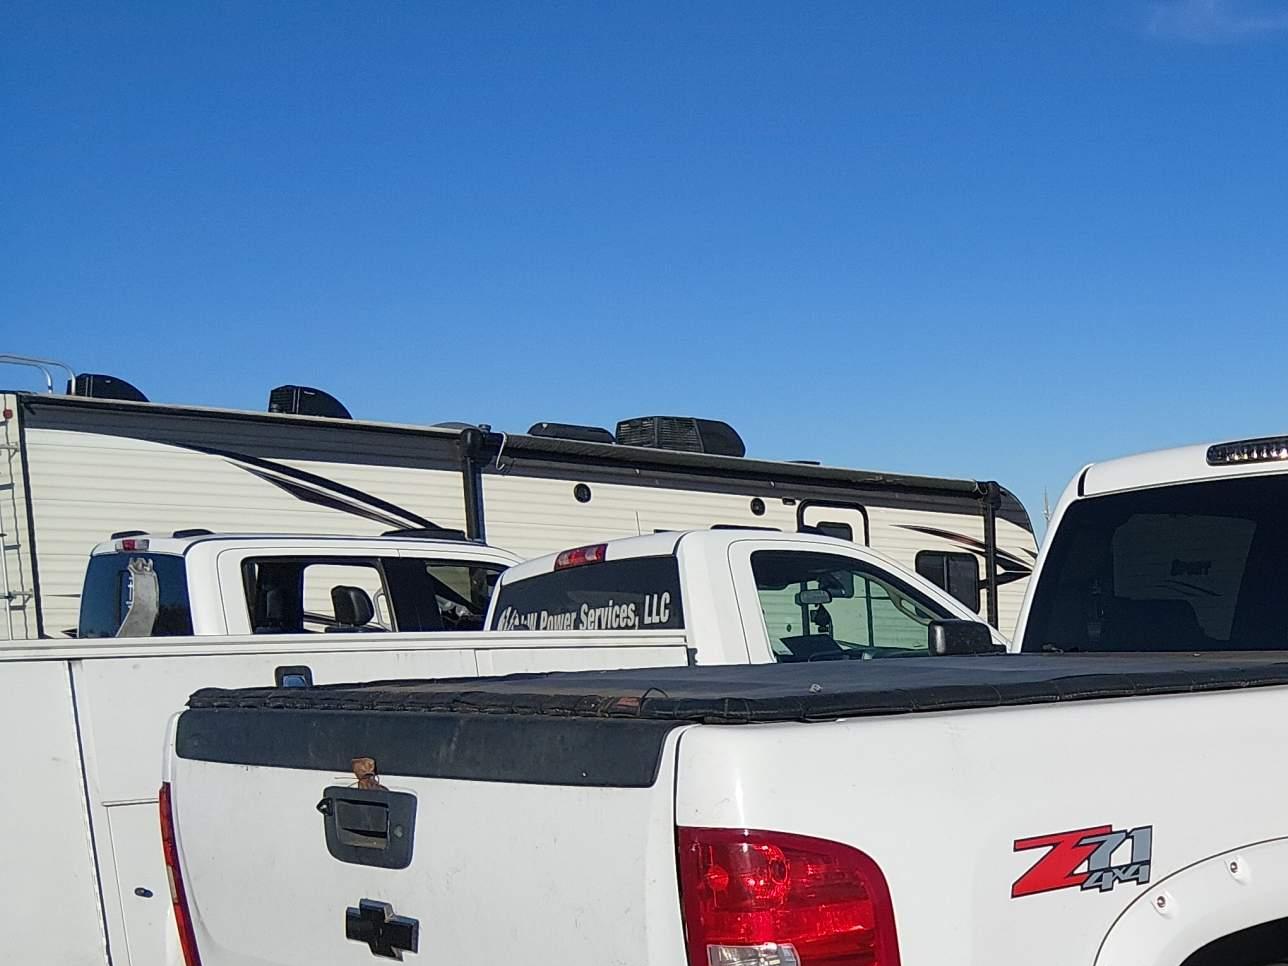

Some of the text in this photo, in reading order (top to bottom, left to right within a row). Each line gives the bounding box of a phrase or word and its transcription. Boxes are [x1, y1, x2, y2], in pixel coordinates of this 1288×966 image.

[540, 610, 577, 631] Power
[579, 600, 639, 630] Services,
[644, 591, 671, 625] LLC
[1011, 824, 1153, 899] Z71
